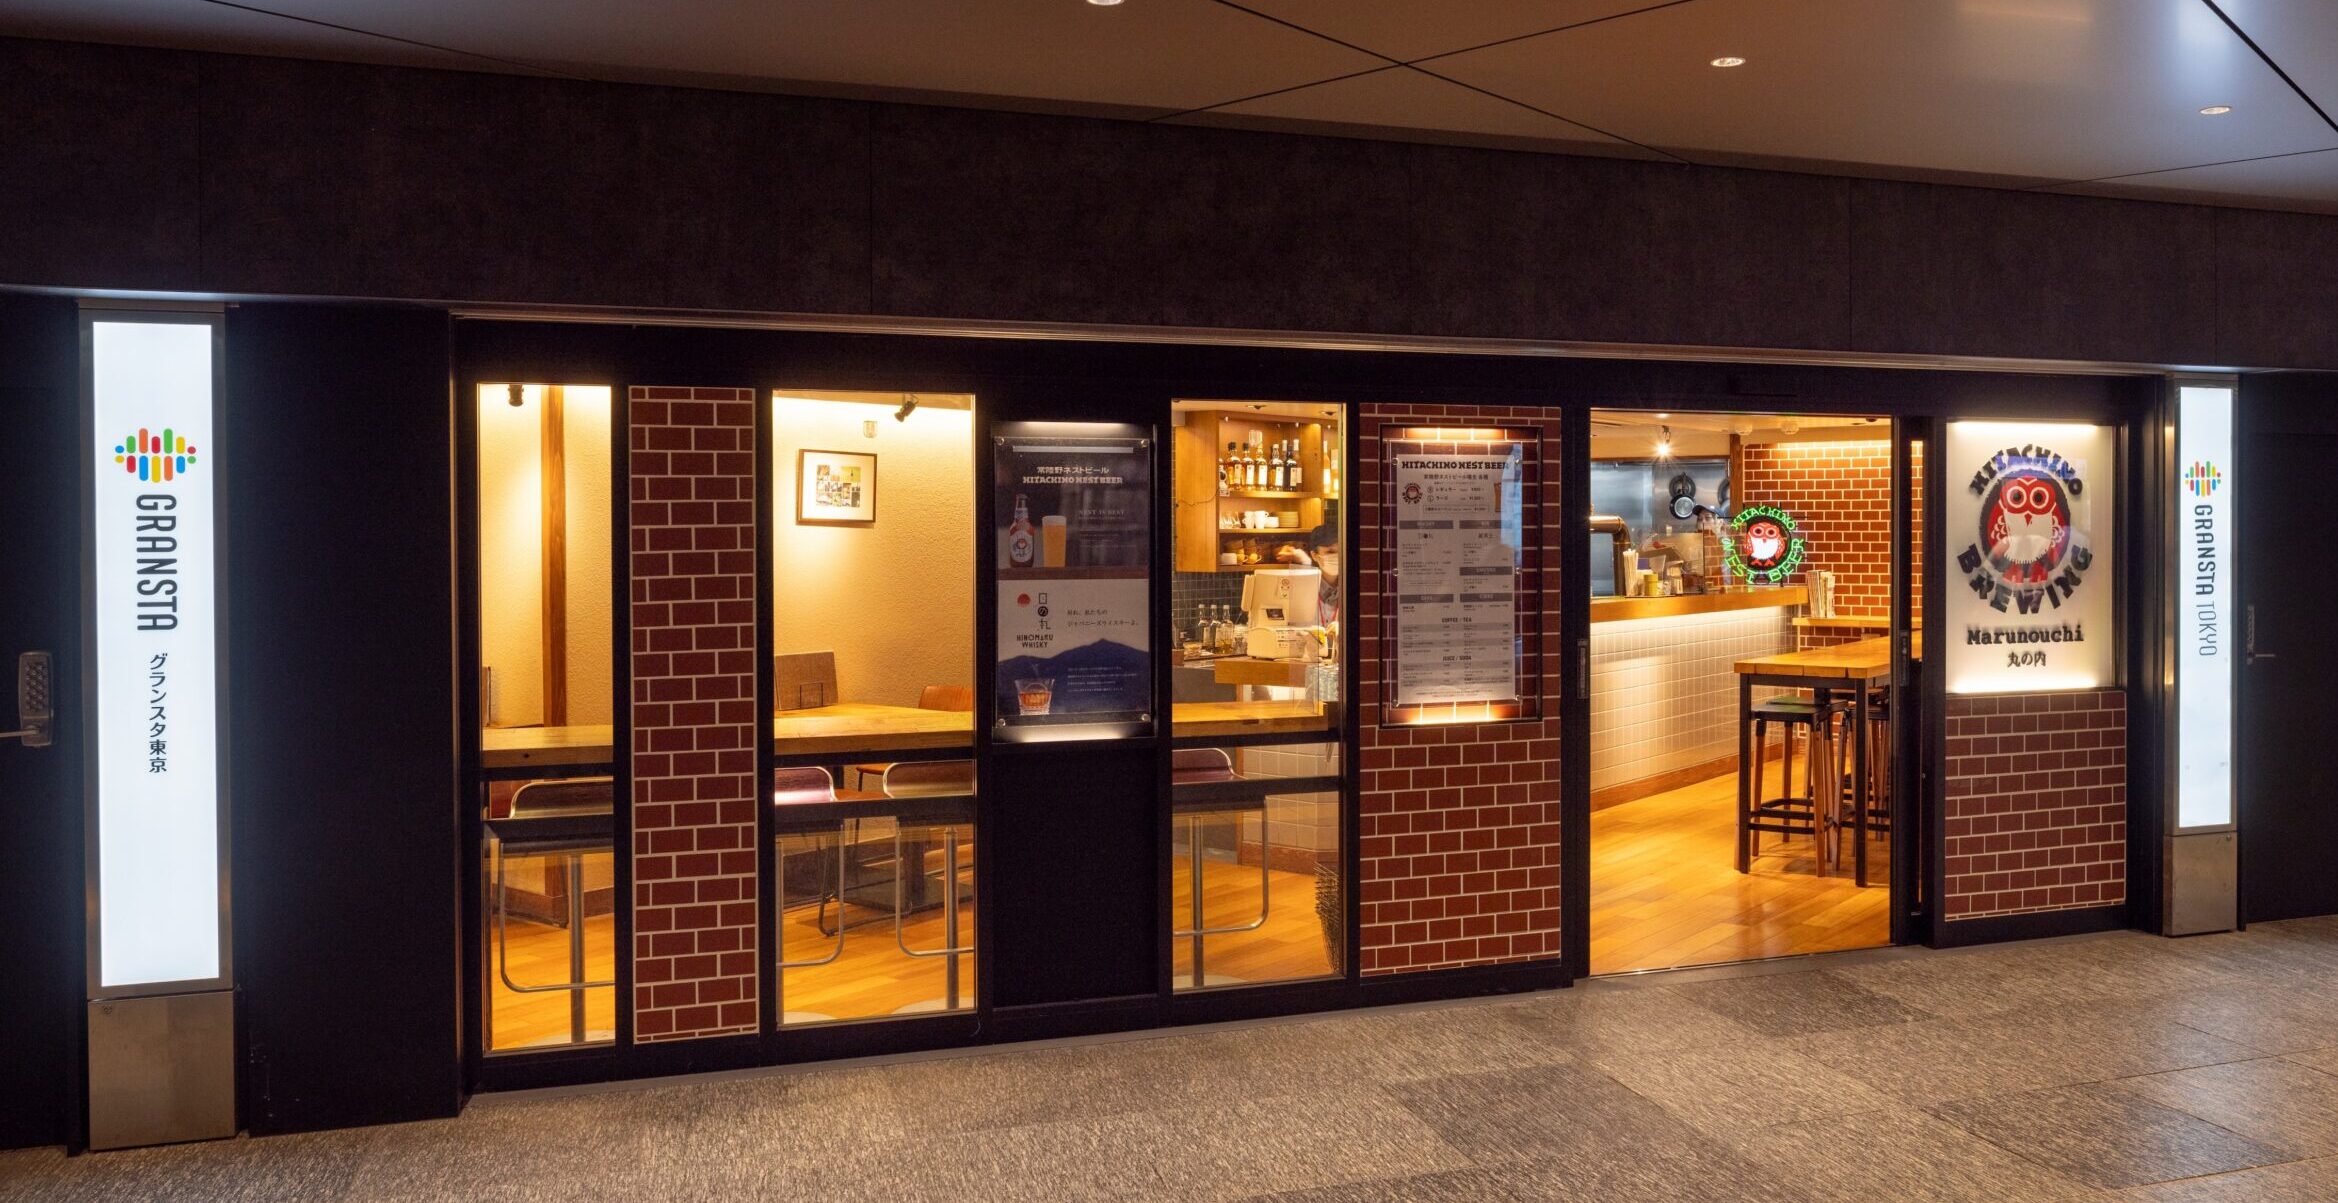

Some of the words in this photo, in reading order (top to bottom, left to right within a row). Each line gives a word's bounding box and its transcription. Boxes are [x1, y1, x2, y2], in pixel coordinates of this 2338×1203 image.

[1023, 476, 1075, 484] HITACHINO
[1076, 476, 1100, 484] NEST
[1100, 476, 1123, 484] BEER
[1036, 466, 1110, 475] 常陸野ネストビール
[1401, 460, 1457, 470] HITACHINO
[1458, 460, 1484, 470] NEST
[1485, 460, 1509, 470] BEER
[1968, 443, 2083, 497] HITACHINO
[1731, 505, 1796, 530] HITACHINO
[136, 494, 178, 631] GRANSTA
[1722, 537, 1756, 585] NEST
[1768, 538, 1805, 583] BEER
[2194, 504, 2216, 596] GRANSTA
[1957, 542, 2093, 615] BREWING
[1967, 624, 2084, 645] Marunouchi
[2196, 601, 2218, 656] TOKYO
[2007, 650, 2047, 668] 丸の内
[149, 653, 168, 774] グランスタ東京
